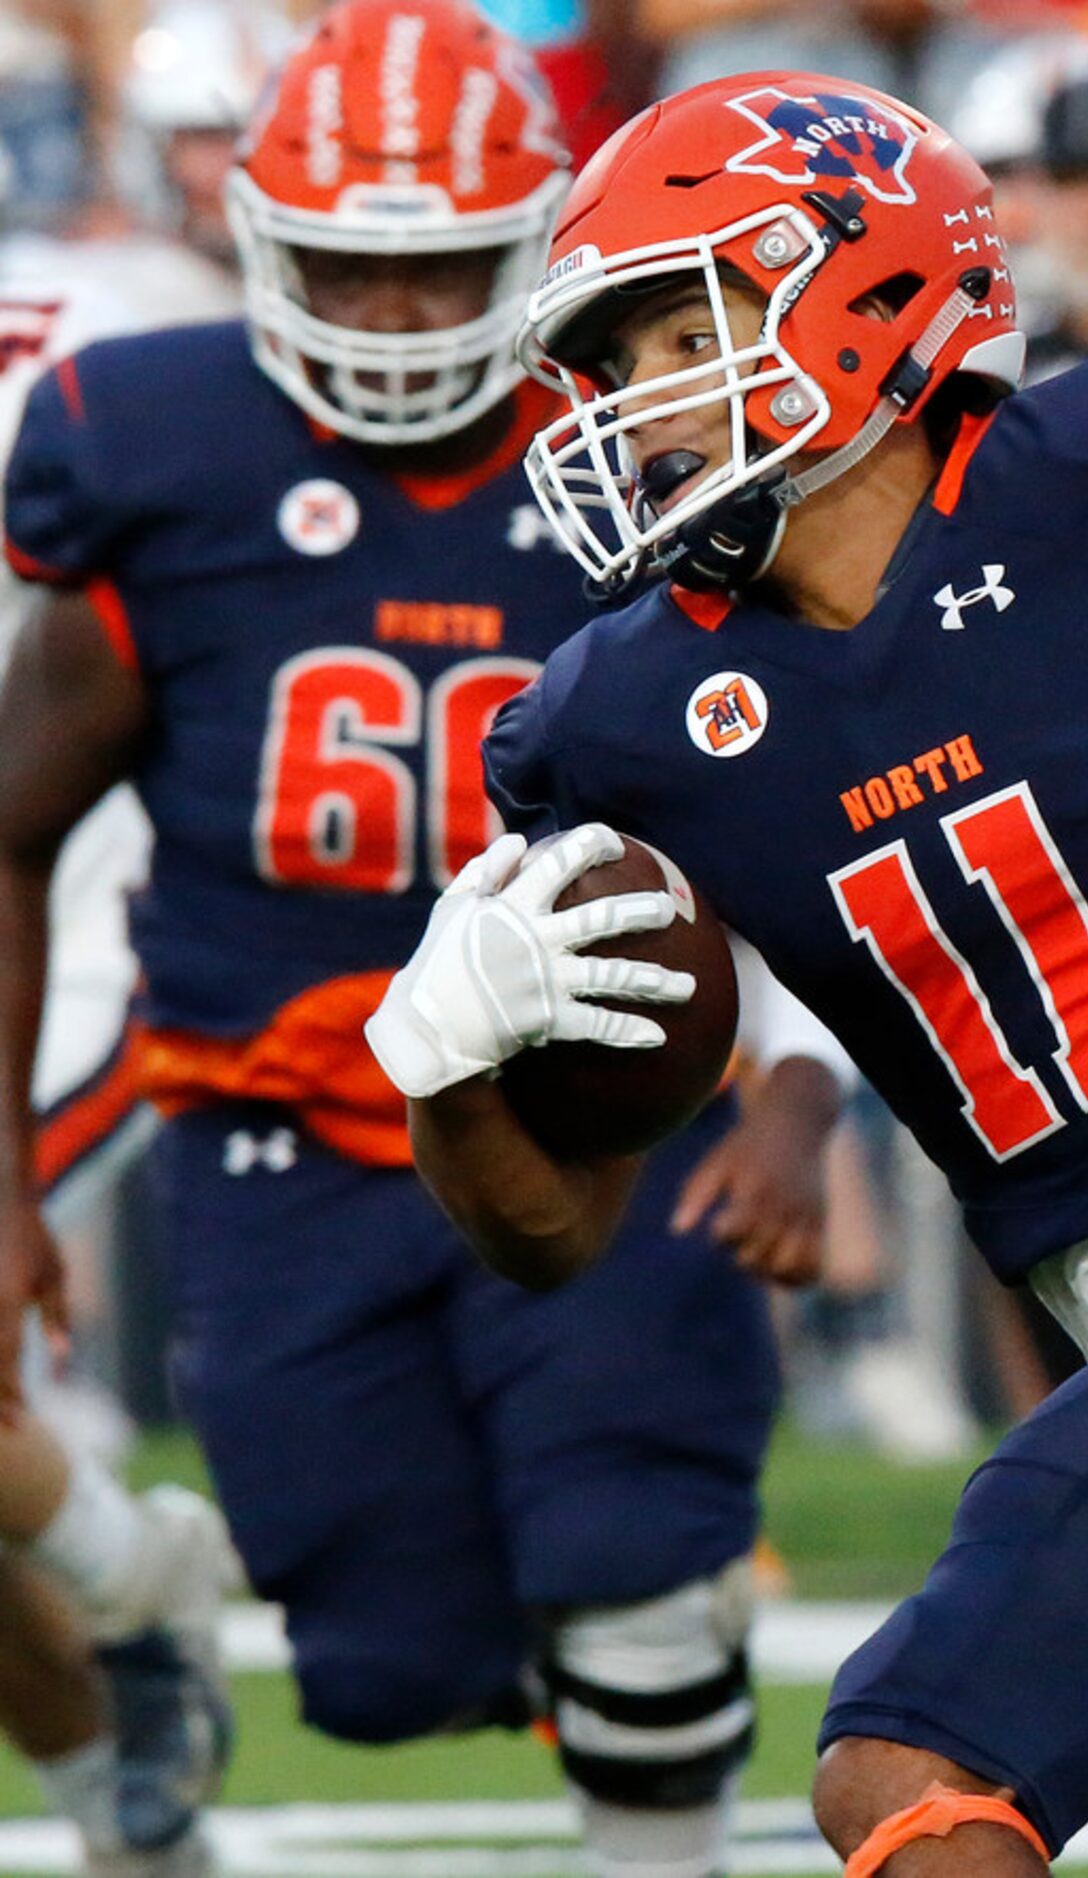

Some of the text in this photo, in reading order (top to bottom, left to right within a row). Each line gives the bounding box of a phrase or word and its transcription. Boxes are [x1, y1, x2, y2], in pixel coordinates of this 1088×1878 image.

[791, 115, 889, 158] NORTH
[695, 677, 762, 751] 21
[839, 734, 984, 833] NORTH
